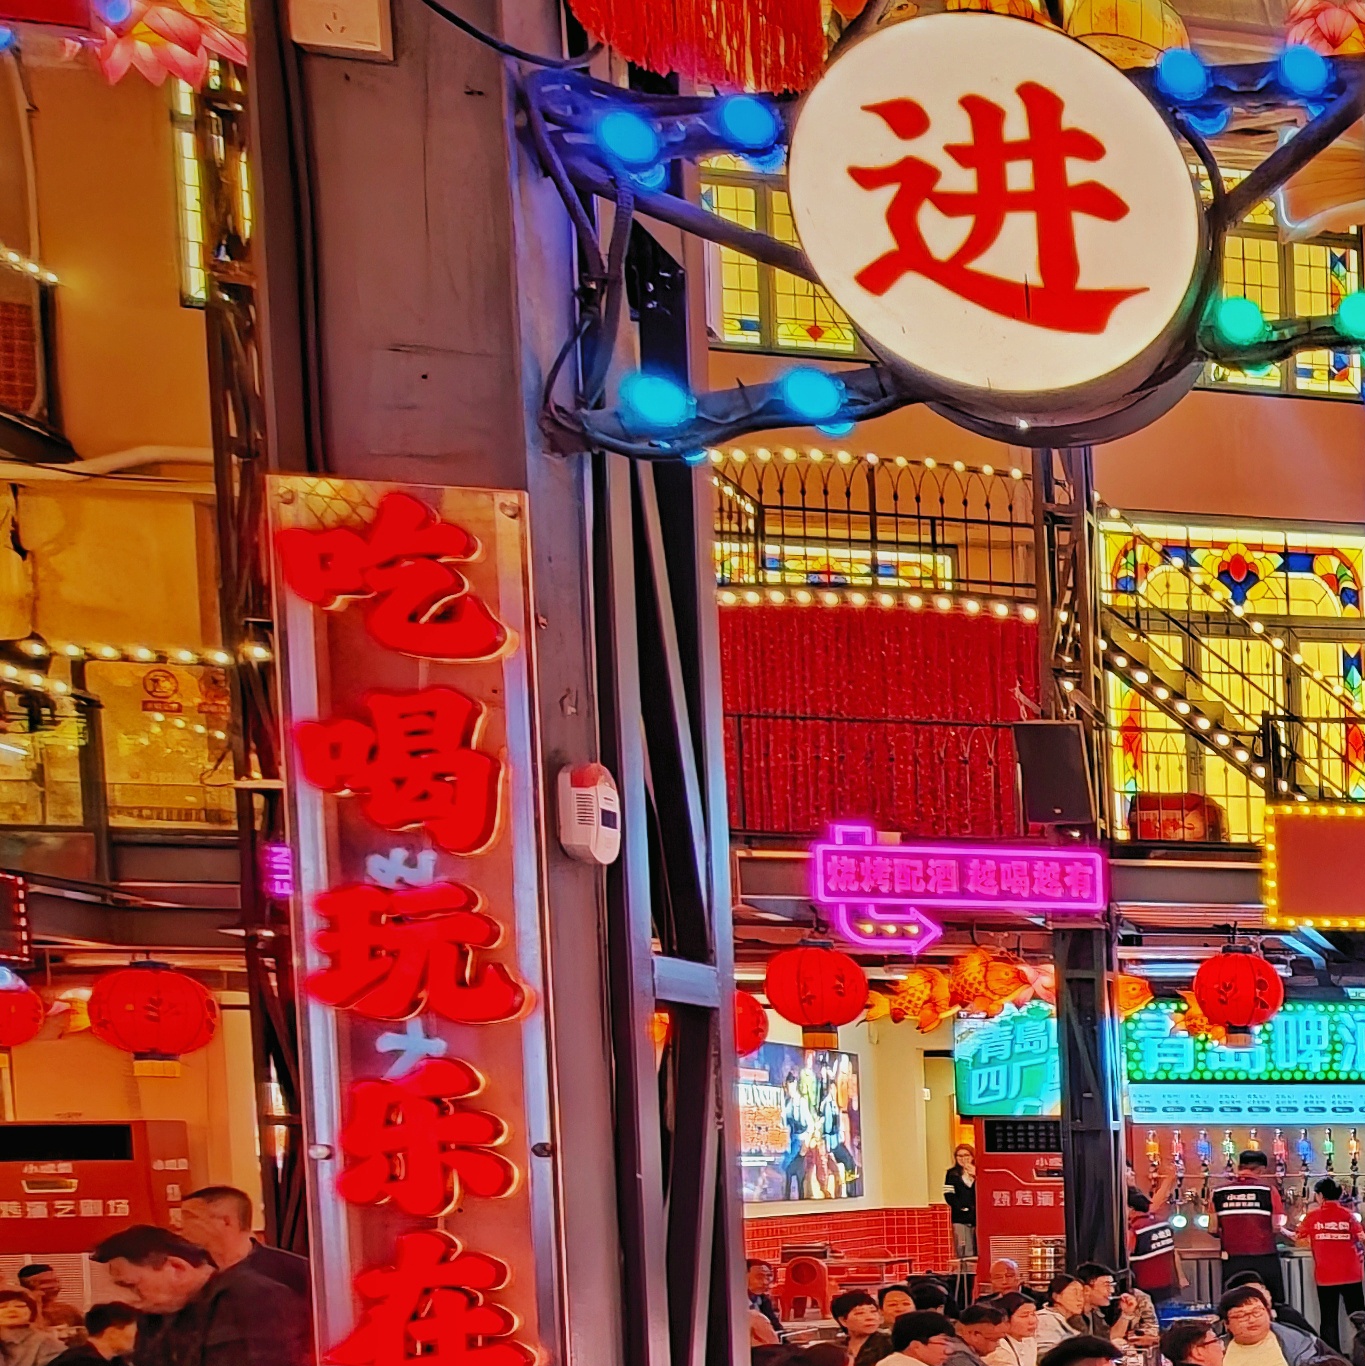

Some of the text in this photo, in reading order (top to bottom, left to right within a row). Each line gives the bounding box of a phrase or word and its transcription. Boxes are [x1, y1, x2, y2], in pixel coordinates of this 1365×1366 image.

[847, 81, 1148, 335] 进
[827, 855, 959, 893] 烧烤配酒
